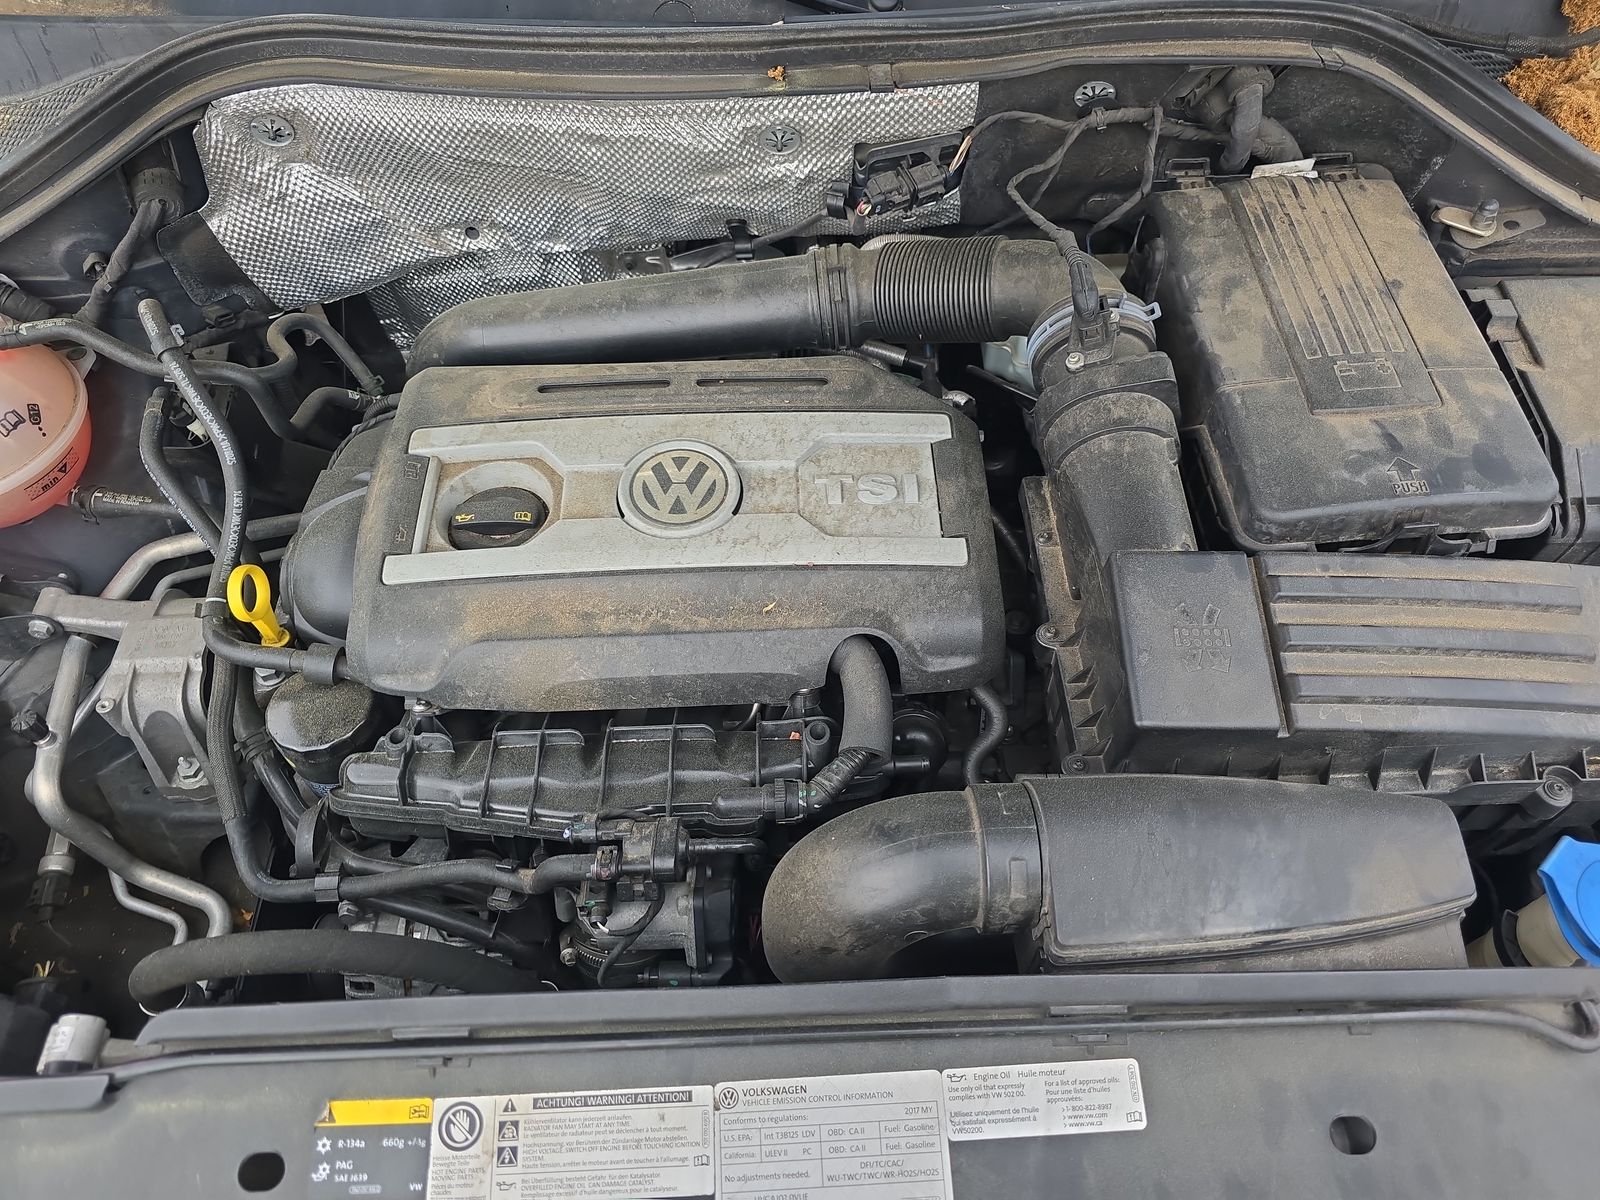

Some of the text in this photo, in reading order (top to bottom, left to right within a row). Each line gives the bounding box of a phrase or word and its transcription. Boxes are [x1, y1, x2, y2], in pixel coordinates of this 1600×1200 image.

[41, 476, 59, 492] min
[814, 473, 923, 505] TSI
[1393, 480, 1428, 495] PUSH
[973, 1071, 1011, 1083] Engine Oil
[1017, 1069, 1066, 1080] Huile moteur
[958, 1084, 974, 1094] only
[974, 1084, 983, 1092] oil
[983, 1083, 997, 1091] that
[997, 1081, 1025, 1092] expressly
[1044, 1080, 1055, 1088] For
[1059, 1079, 1070, 1087] list
[1070, 1078, 1078, 1086] of
[1078, 1077, 1106, 1087] approved
[741, 1084, 807, 1097] VOLKSWAGEN
[948, 1092, 977, 1102] complies
[977, 1091, 991, 1099] with
[991, 1091, 1003, 1099] VW
[1003, 1090, 1015, 1098] 502
[1045, 1088, 1060, 1096] Pour
[1074, 1086, 1087, 1094] liste
[536, 1091, 690, 1109] ACHTUNG! WARNING! ATTENTION!
[742, 1091, 893, 1107] VEHICLE EMISSION CONTROL INFORMATION
[904, 1105, 933, 1115] 2017 MY
[973, 1107, 1012, 1119] uniquement
[723, 1113, 809, 1126] Conforms to regulations:
[827, 1128, 846, 1137] OBD:
[848, 1127, 859, 1136] CA
[884, 1122, 935, 1134] Fuel: Gasoline
[764, 1131, 775, 1140] Int
[801, 1129, 817, 1138] LDV
[338, 1137, 405, 1150] R-134a 660g
[828, 1145, 847, 1155] OBD:
[850, 1144, 860, 1153] CA
[885, 1139, 936, 1151] Fuel: Gasoline
[723, 1150, 757, 1160] California:
[764, 1149, 783, 1158] ULEV
[802, 1147, 812, 1156] PC
[335, 1160, 354, 1171] PAG
[859, 1158, 905, 1170] DFI/TC/CAC/
[334, 1172, 368, 1184] SAE J639
[724, 1168, 810, 1184] No adjustments needed.
[409, 1182, 423, 1192] VW
